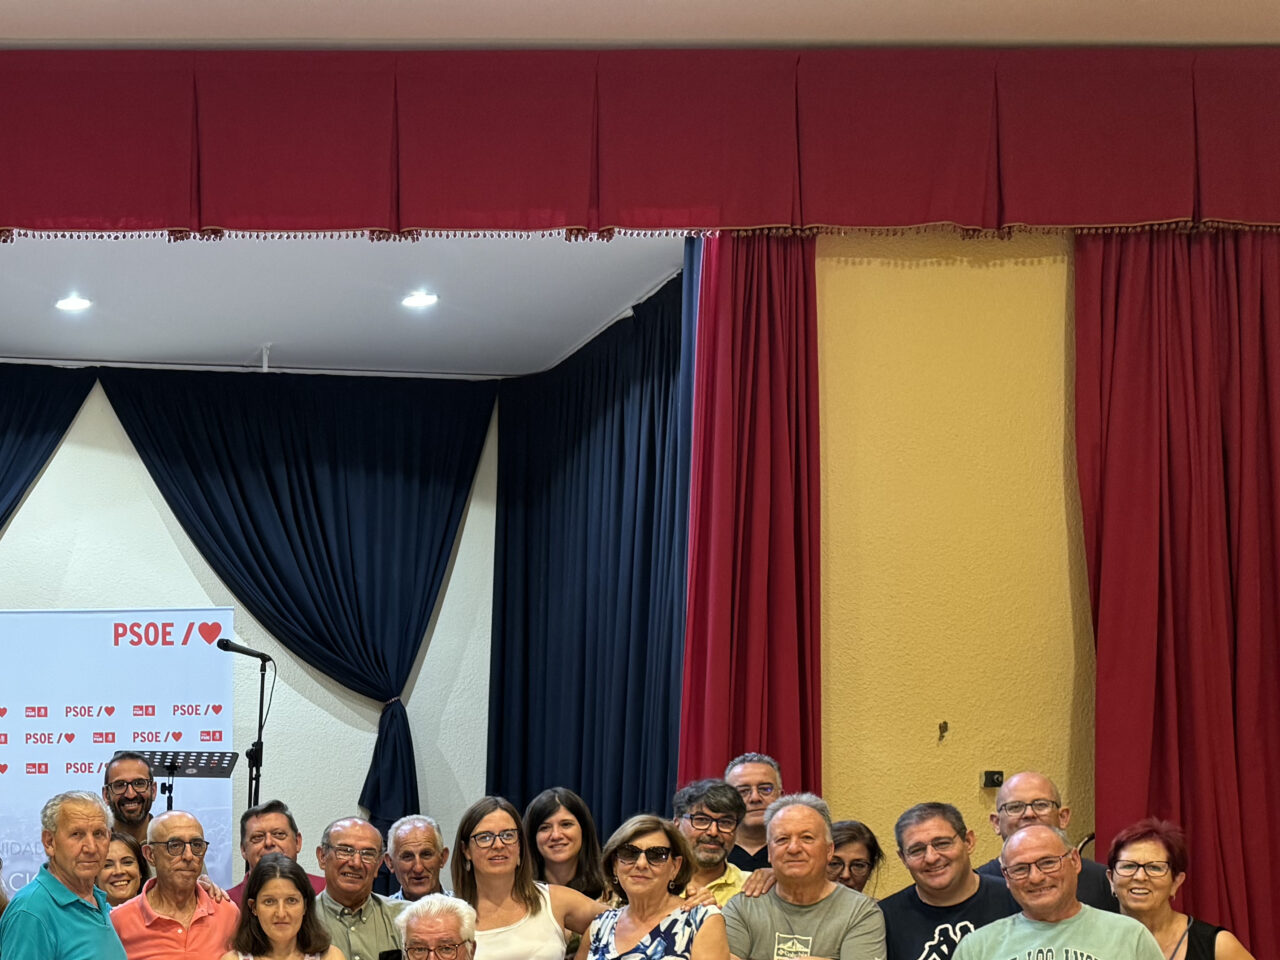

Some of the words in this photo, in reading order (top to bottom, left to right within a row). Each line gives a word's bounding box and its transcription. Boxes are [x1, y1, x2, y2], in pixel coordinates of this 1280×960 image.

[113, 622, 175, 647] PSOE
[65, 706, 94, 717] PSOE
[173, 704, 201, 716] PSOE
[25, 733, 54, 744] PSOE
[133, 731, 161, 743] PSOE
[65, 762, 94, 774] PSOE
